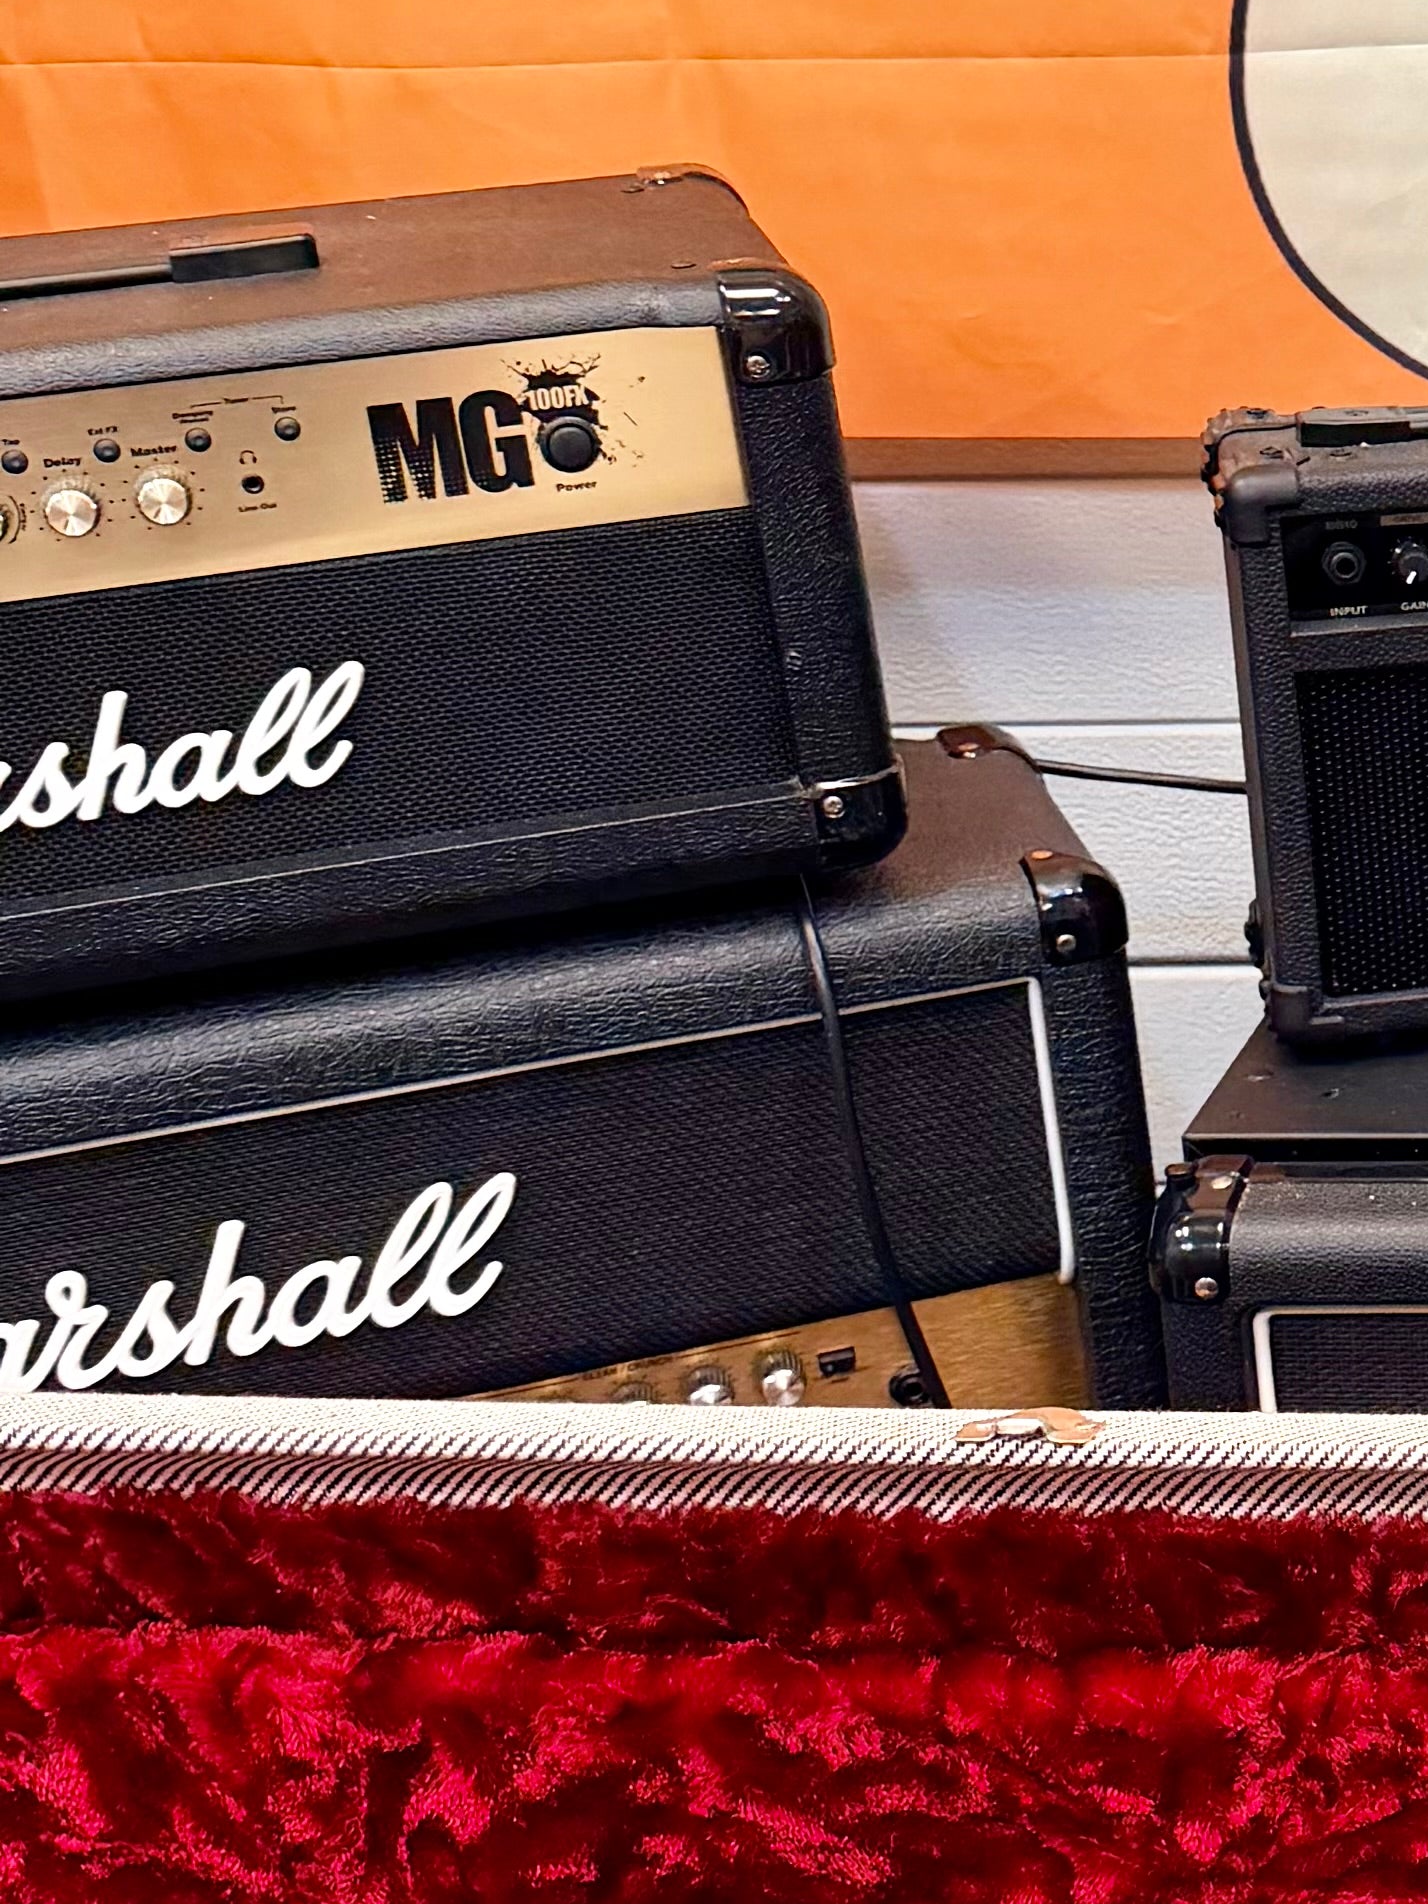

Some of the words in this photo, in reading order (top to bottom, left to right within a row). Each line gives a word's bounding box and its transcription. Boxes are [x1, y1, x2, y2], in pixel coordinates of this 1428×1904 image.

[526, 384, 590, 411] 100FX
[130, 445, 178, 457] Master
[366, 389, 535, 504] MG
[43, 456, 82, 468] Delay
[555, 479, 598, 492] Power
[1329, 604, 1369, 617] INPUT
[0, 660, 366, 833] shall
